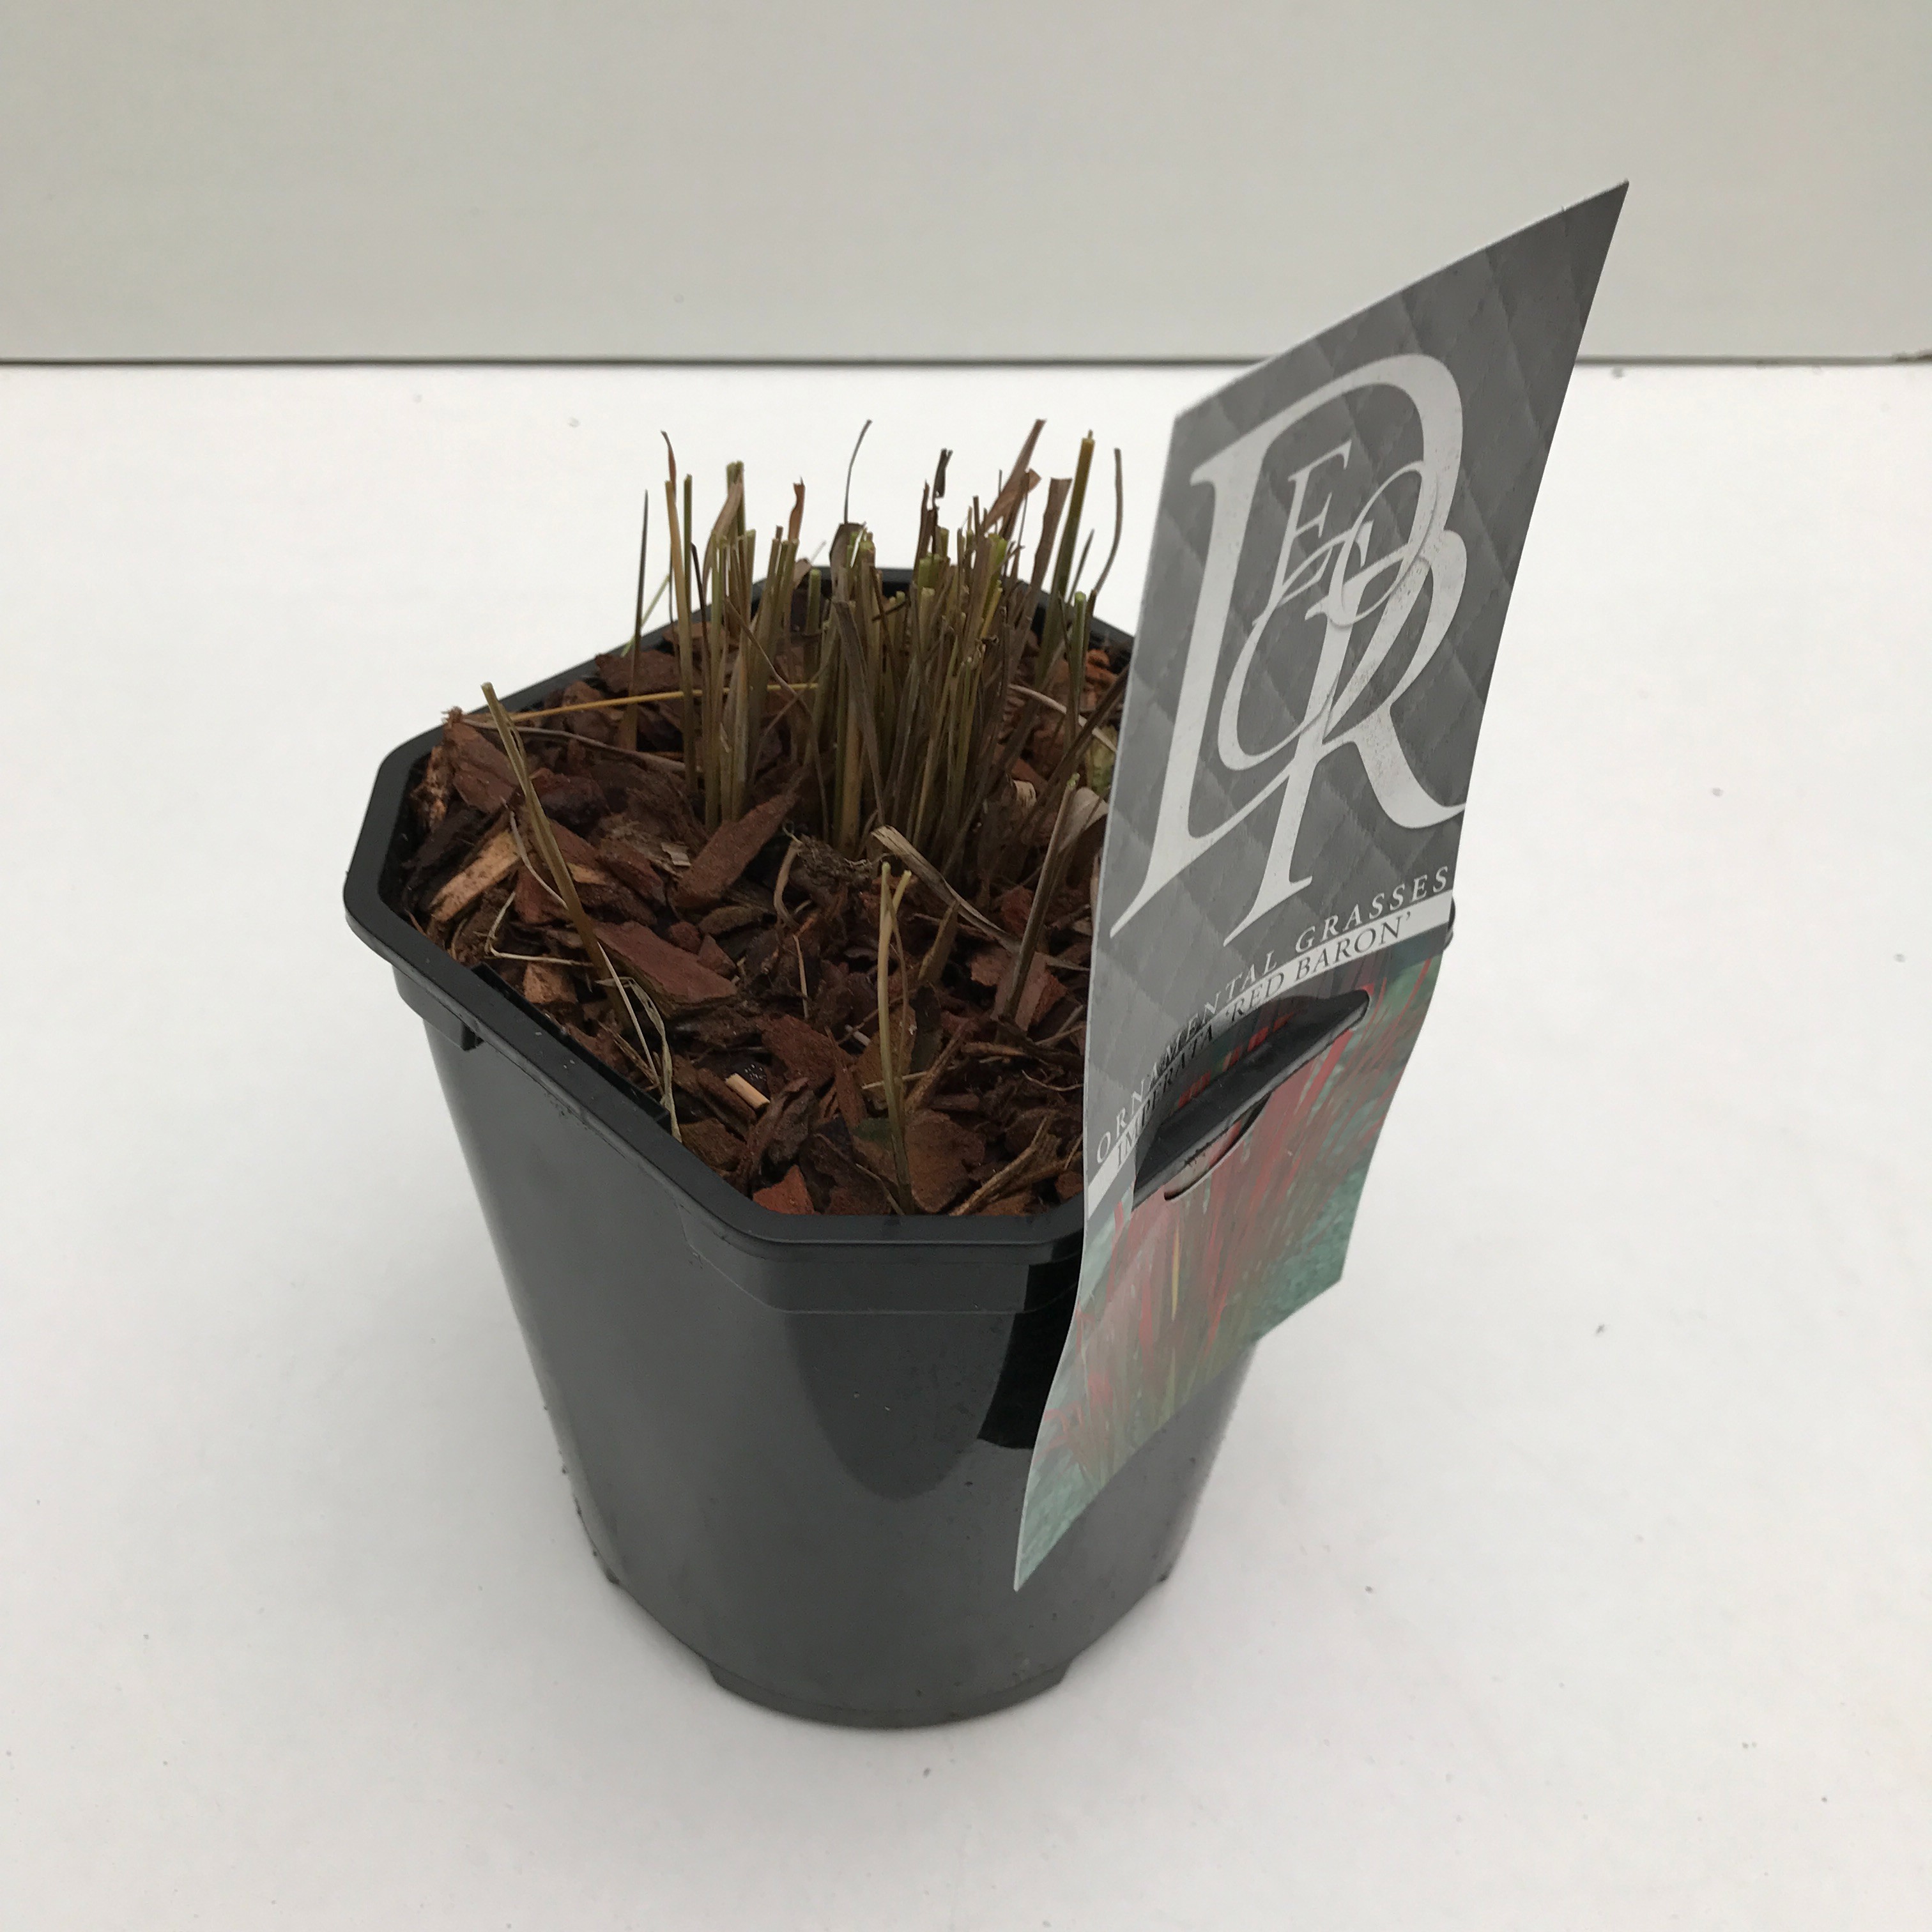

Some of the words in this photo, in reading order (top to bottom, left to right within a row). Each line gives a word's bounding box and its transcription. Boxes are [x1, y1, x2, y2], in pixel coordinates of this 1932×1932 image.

[1097, 949, 1277, 1164] ORNAMENTAL
[1294, 866, 1448, 953] GRASSES
[1295, 910, 1411, 981] BARON'
